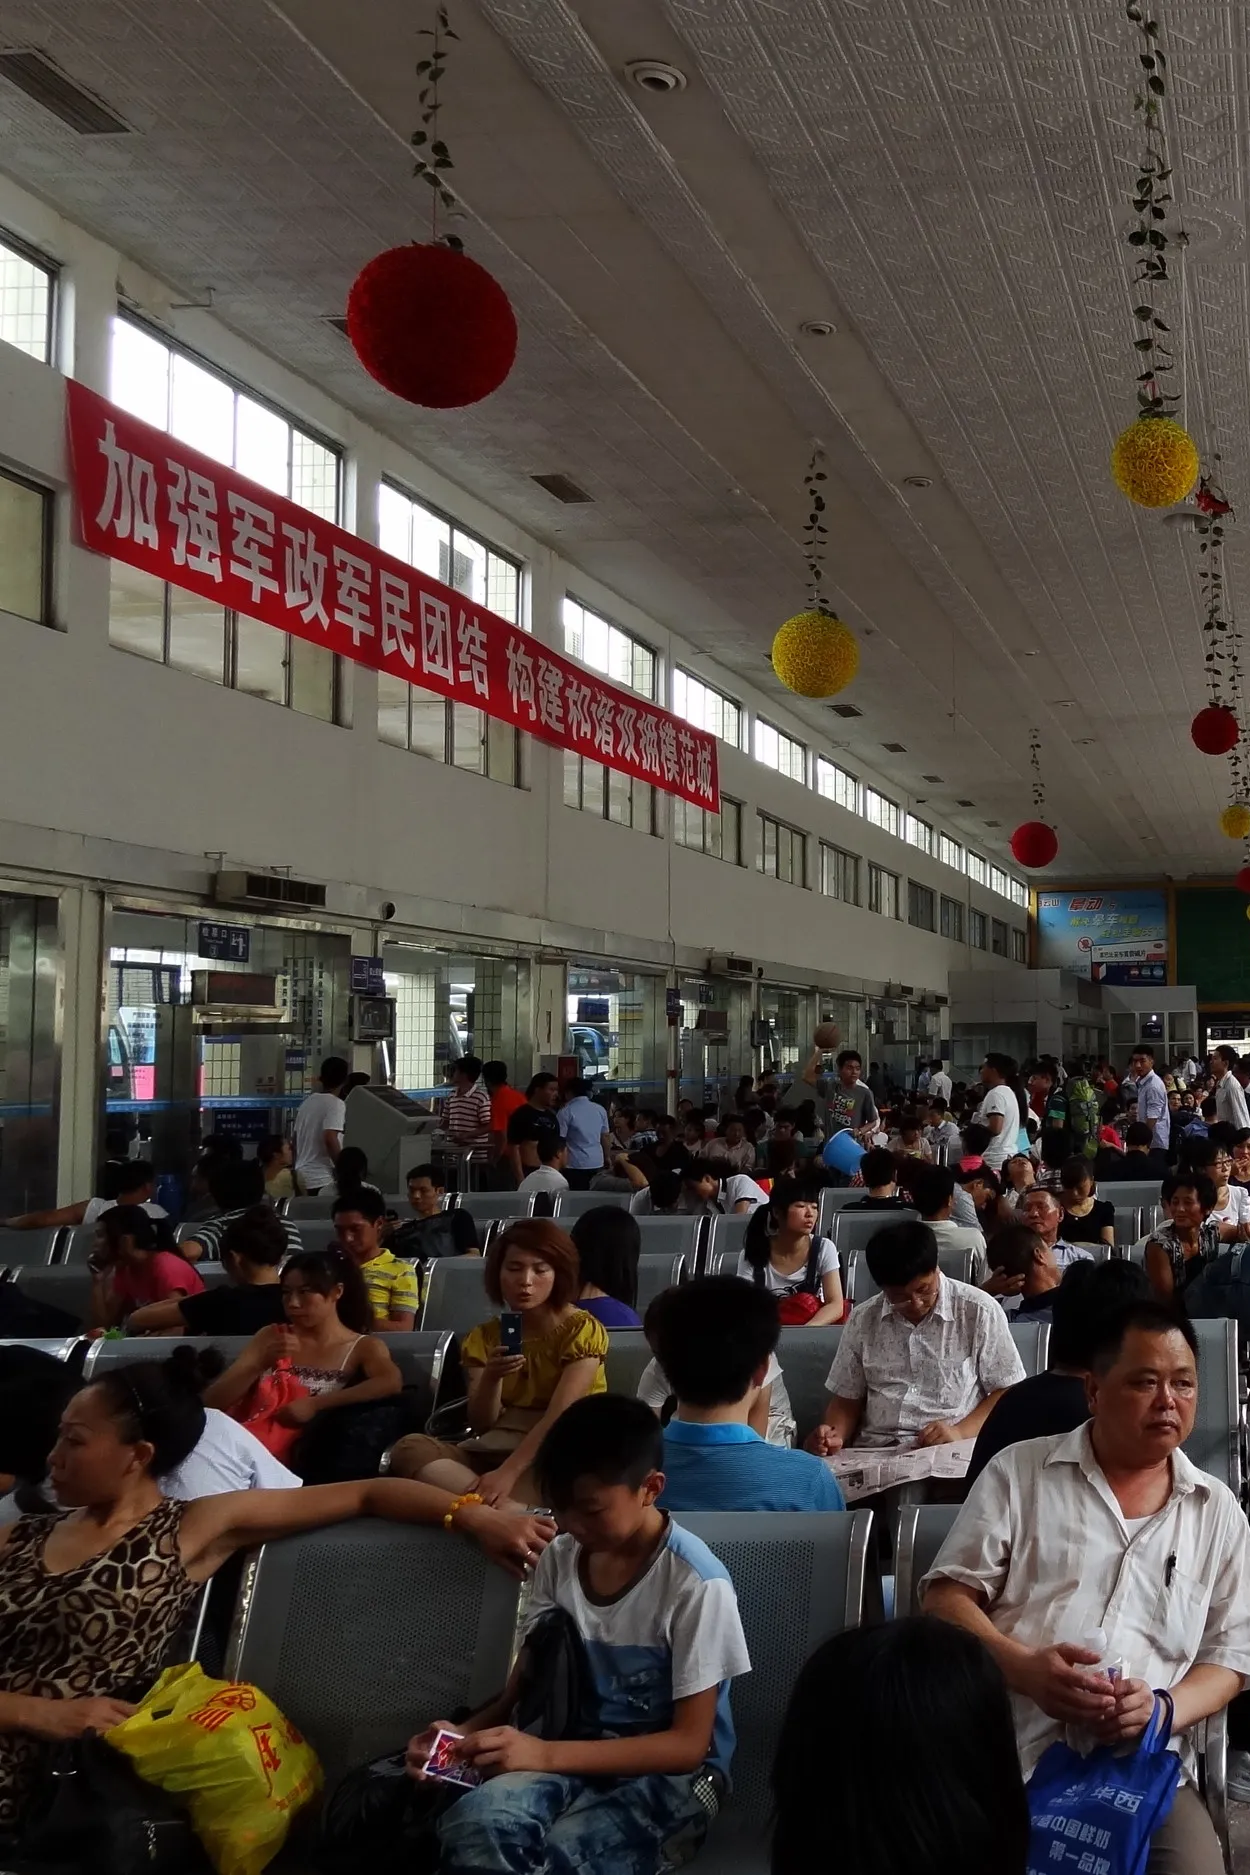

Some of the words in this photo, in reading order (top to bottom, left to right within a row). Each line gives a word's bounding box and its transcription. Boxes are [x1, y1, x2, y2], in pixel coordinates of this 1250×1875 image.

[97, 418, 490, 700] 加强军政军民团结
[506, 636, 713, 803] 构建和谐双拥模范城
[1090, 1785, 1144, 1813] 华西
[1049, 1839, 1111, 1875] 第一品牌
